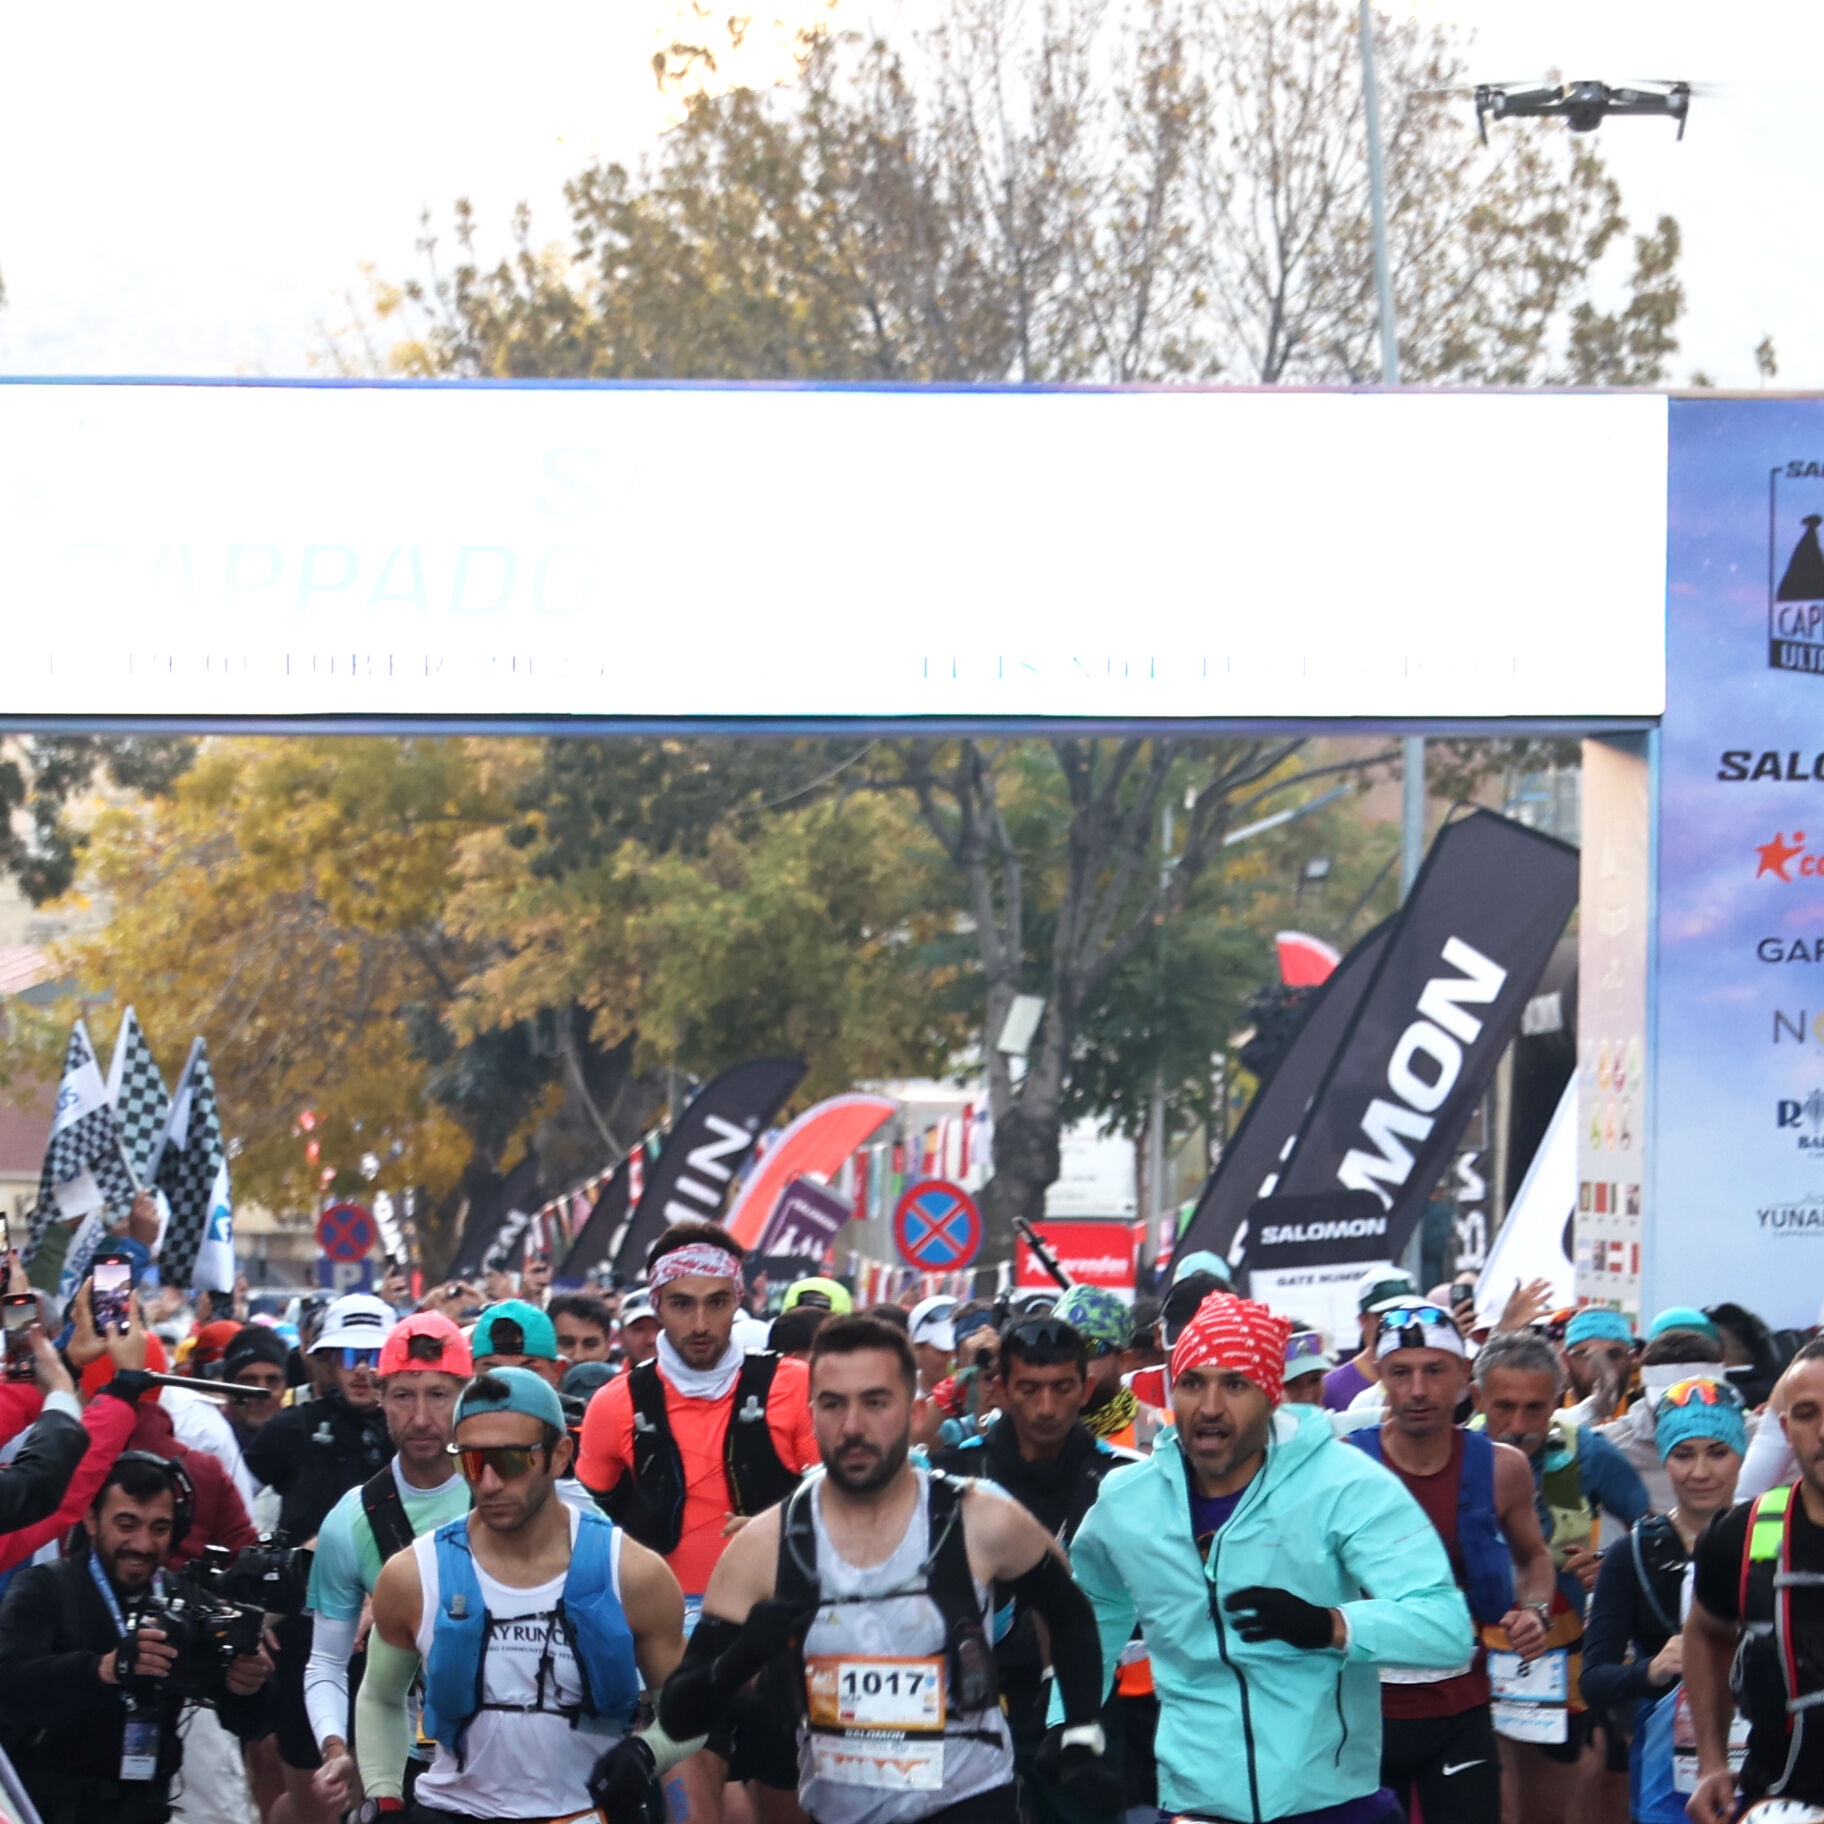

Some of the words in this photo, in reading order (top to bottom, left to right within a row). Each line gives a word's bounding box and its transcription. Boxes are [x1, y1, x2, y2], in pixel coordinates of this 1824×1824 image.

[1261, 1216, 1387, 1245] SALOMON
[333, 1262, 363, 1295] P
[514, 1626, 548, 1643] RUN
[842, 1670, 925, 1696] 1017
